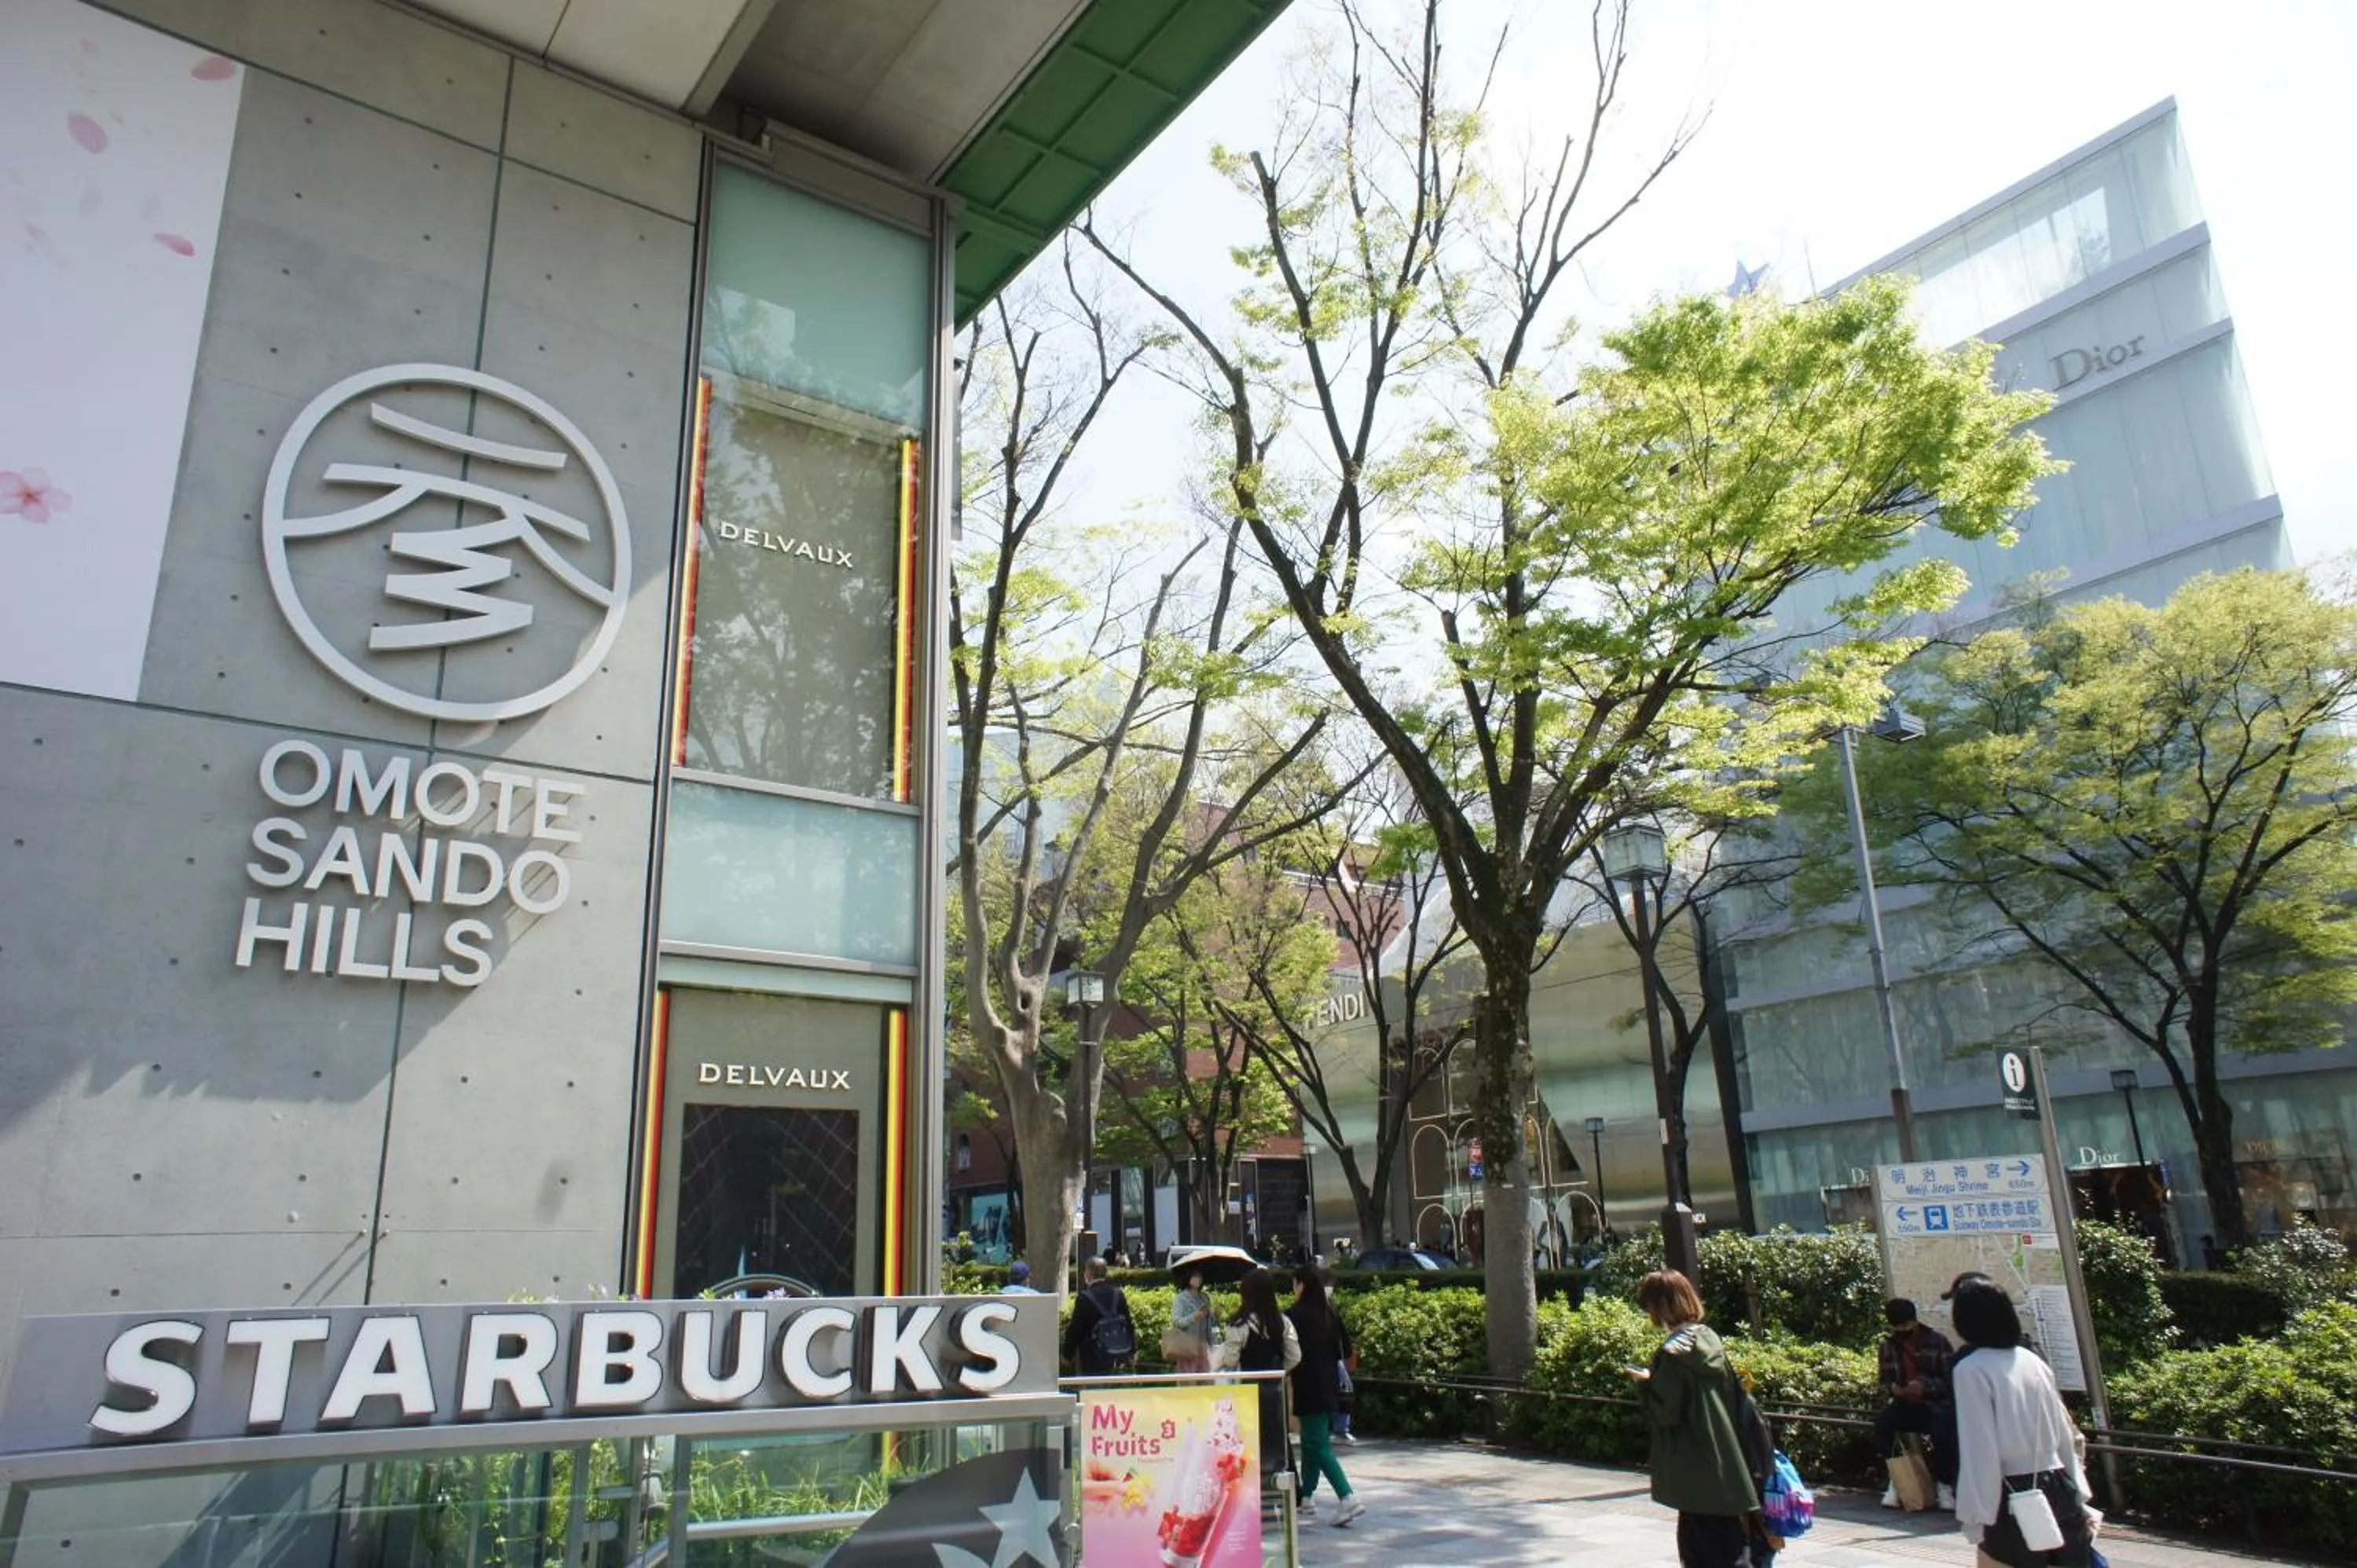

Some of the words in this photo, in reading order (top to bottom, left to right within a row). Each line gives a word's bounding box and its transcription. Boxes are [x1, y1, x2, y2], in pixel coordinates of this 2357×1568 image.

[2049, 332, 2147, 392] Dior
[720, 520, 854, 569] DELVAUX
[258, 738, 586, 843] OMOTE
[245, 816, 571, 915] SANDO
[235, 896, 494, 987] HILLS
[698, 1062, 852, 1091] DELVAUX
[2078, 1145, 2119, 1165] Dior
[1849, 1167, 1869, 1184] Di
[1958, 1181, 1989, 1192] Shrine
[90, 1301, 1021, 1439] STARBUCKS
[1091, 1405, 1134, 1434] My
[1091, 1432, 1160, 1456] Fruits
